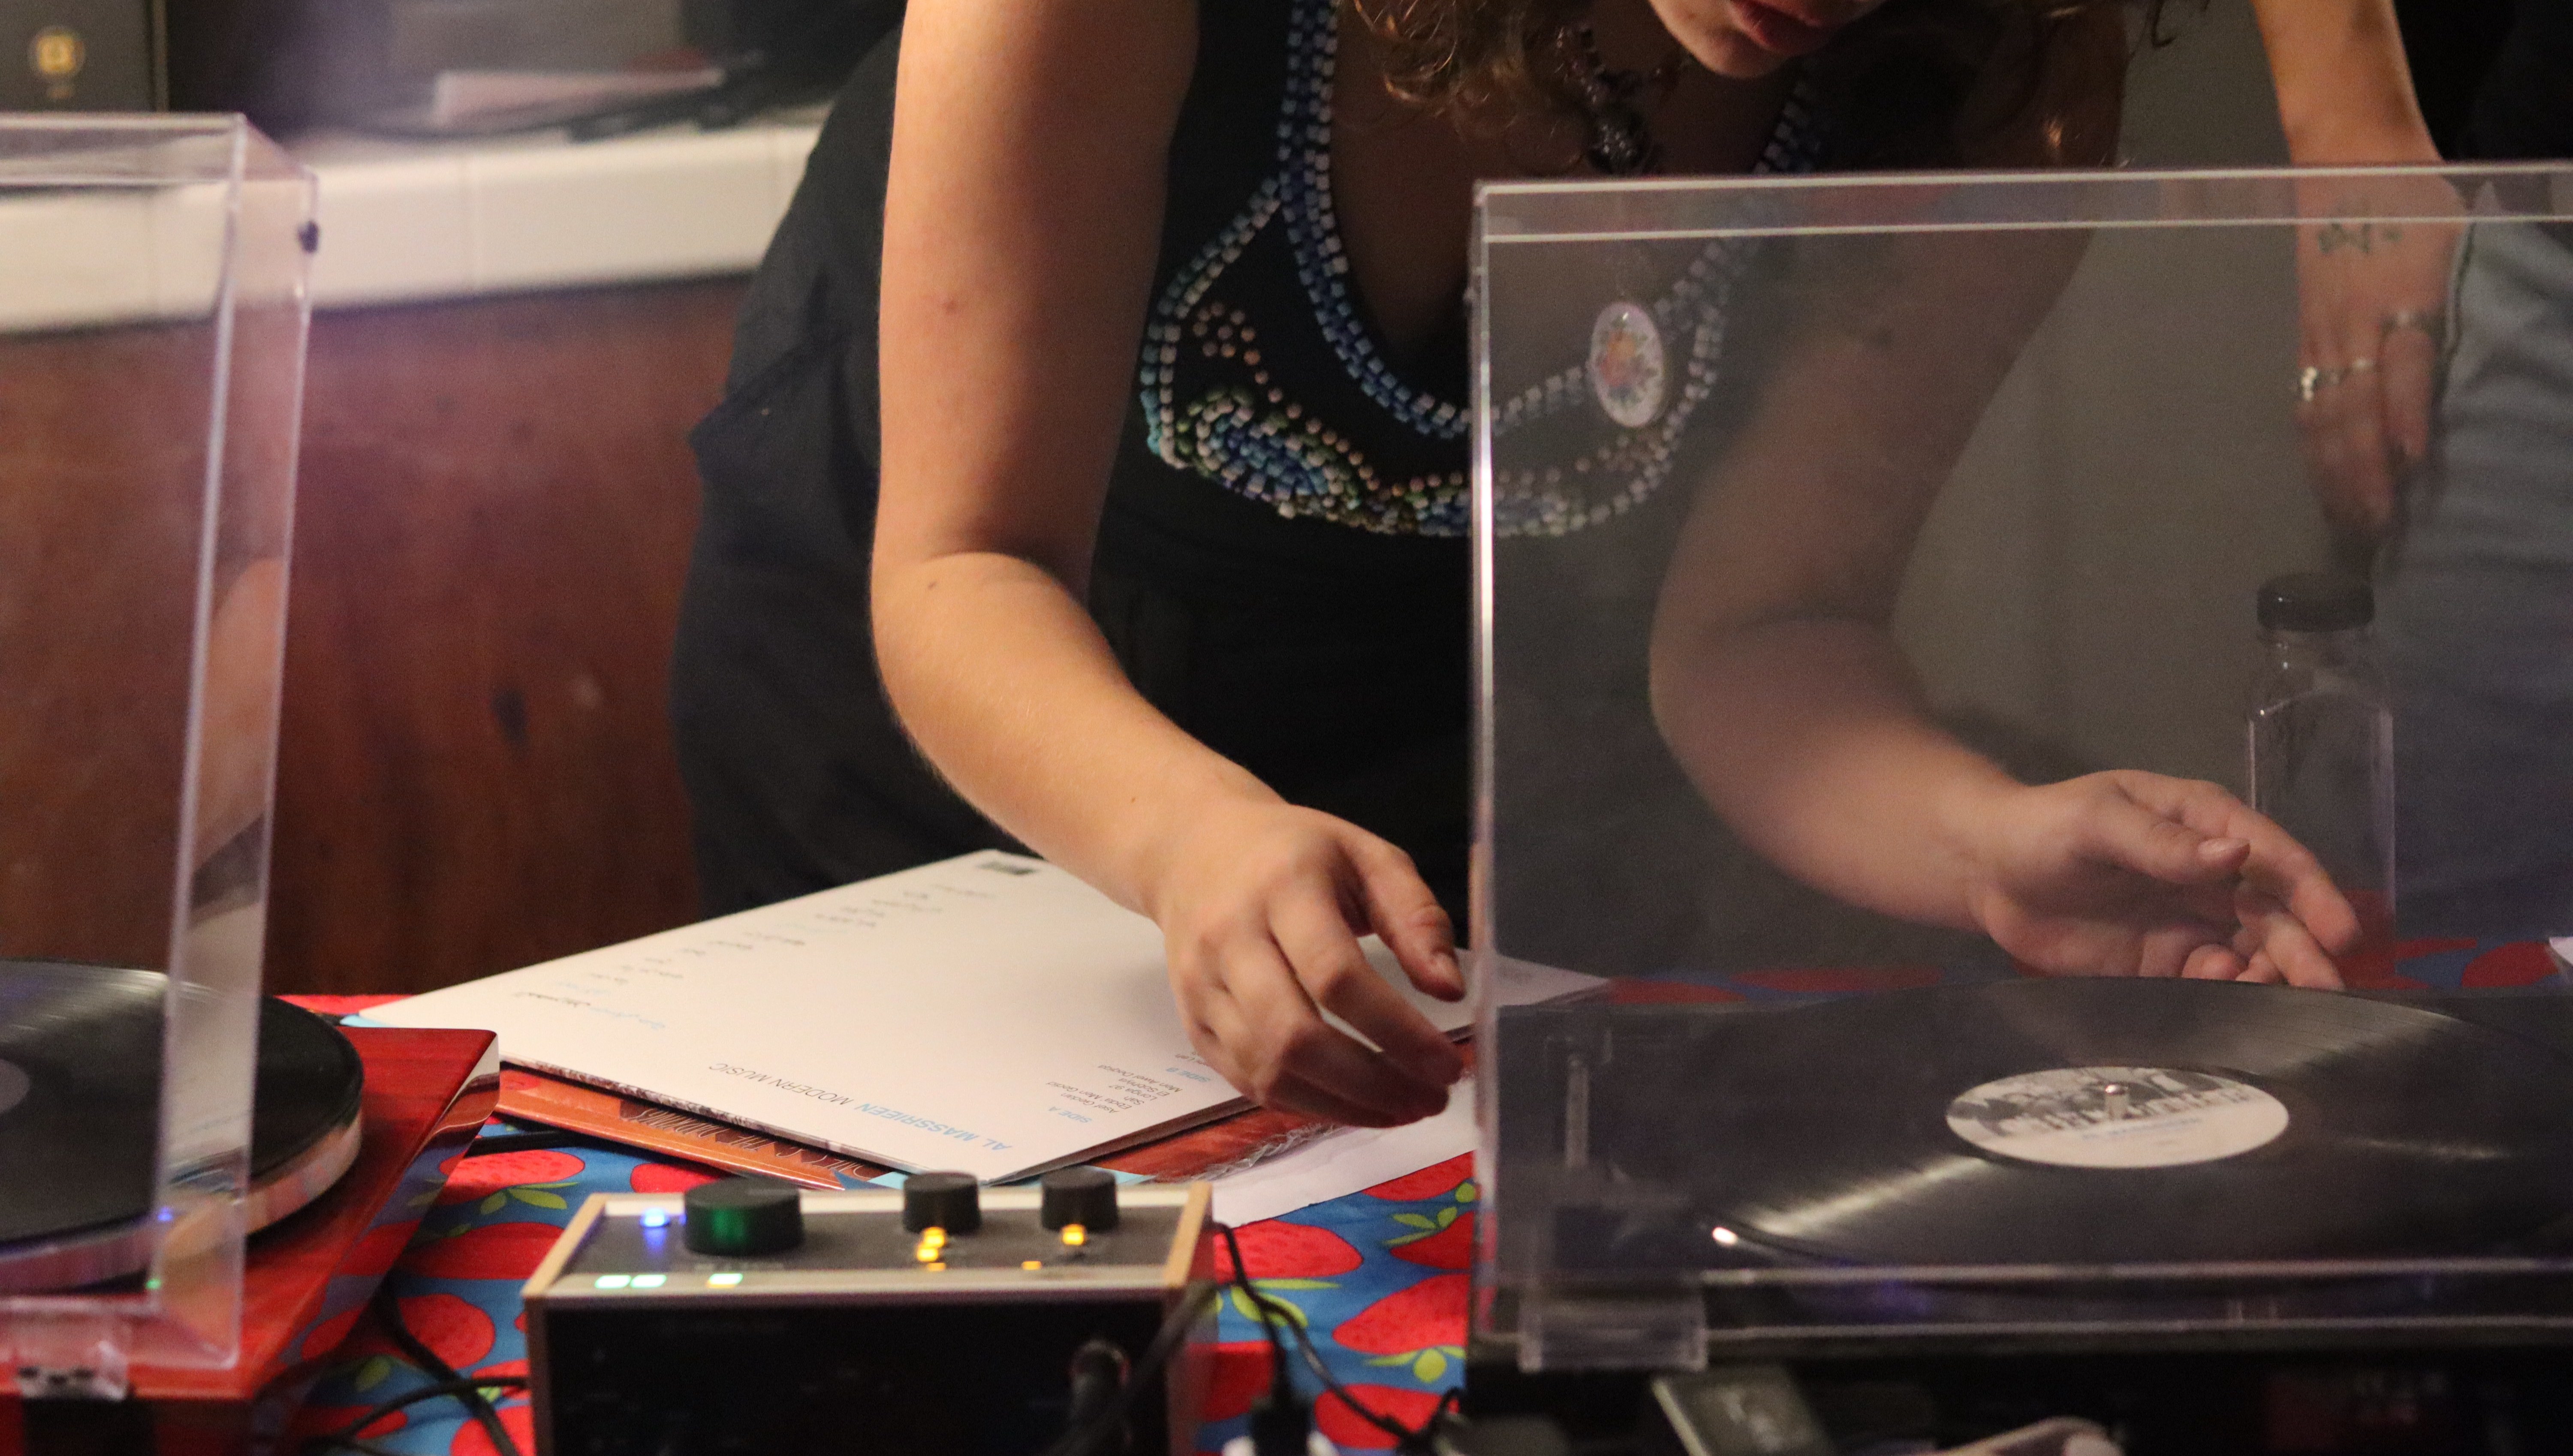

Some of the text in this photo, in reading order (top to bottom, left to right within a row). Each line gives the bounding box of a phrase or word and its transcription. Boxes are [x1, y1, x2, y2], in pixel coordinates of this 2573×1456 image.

[1180, 1071, 1211, 1082] SIDE
[1160, 1083, 1182, 1092] Men
[1079, 1091, 1102, 1099] Men
[709, 1064, 1012, 1150] AL MASSRIEEN MODERN MUSIC
[1058, 1111, 1092, 1123] SIDE
